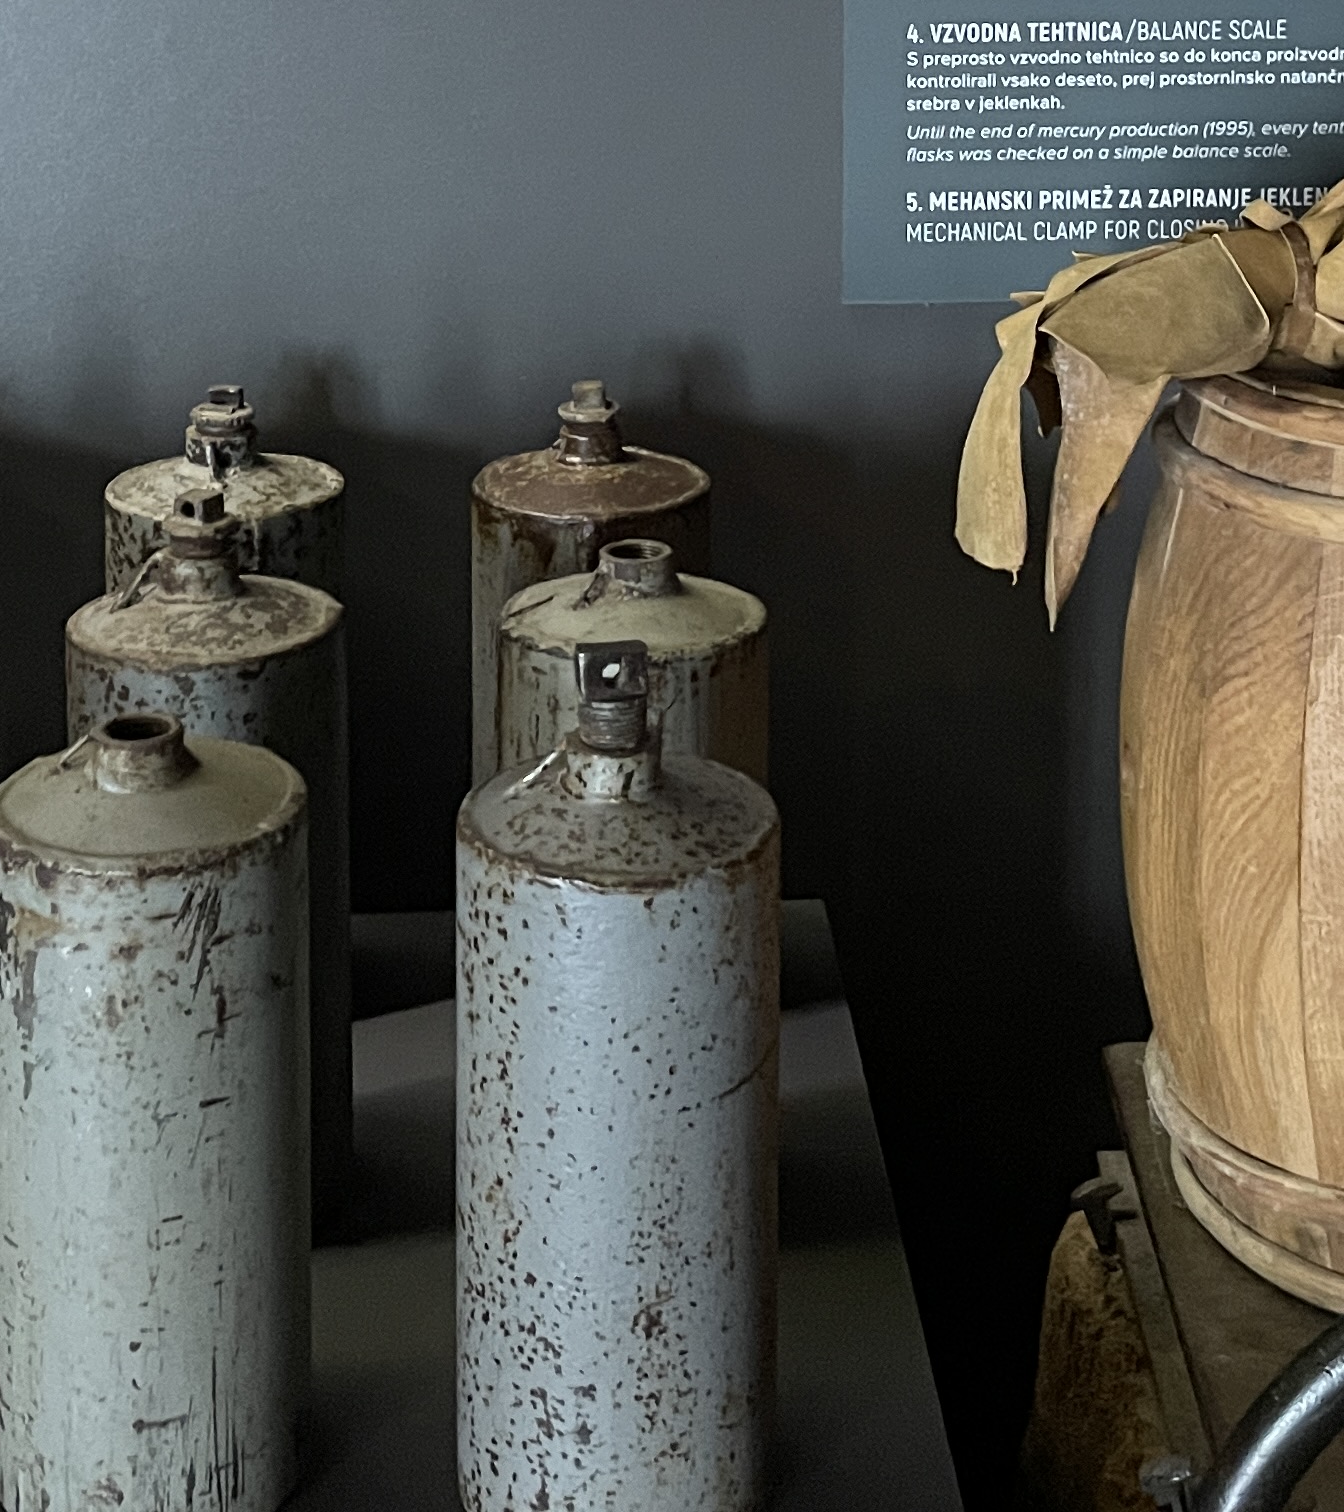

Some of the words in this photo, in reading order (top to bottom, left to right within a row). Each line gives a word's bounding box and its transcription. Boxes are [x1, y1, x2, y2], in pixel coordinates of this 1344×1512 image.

[907, 192, 922, 211] 5.
[930, 191, 1031, 211] MEHANSKI
[1040, 185, 1113, 209] PRIMEŽ
[1119, 189, 1142, 208] ZA
[1148, 188, 1250, 210] ZAPIRANJE
[907, 222, 1027, 242] MECHANICAL
[1034, 221, 1097, 240] CLAMP
[1105, 220, 1140, 239] FOR
